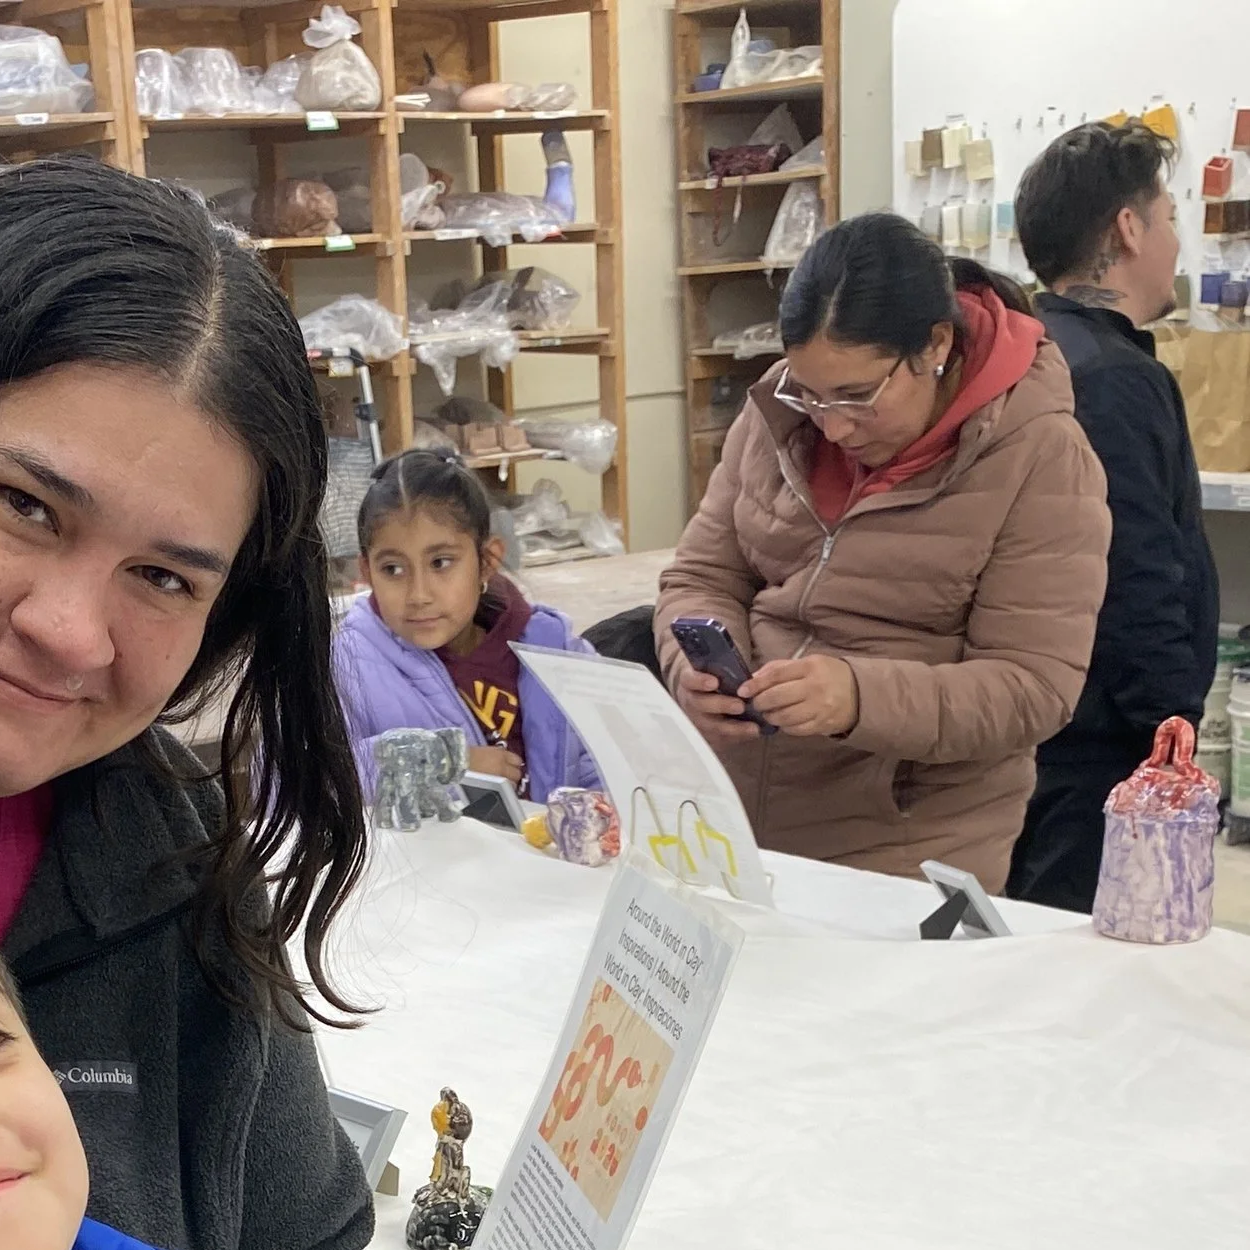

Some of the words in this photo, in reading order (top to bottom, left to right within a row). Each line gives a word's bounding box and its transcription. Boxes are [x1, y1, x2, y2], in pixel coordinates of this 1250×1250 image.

[626, 898, 652, 929] Around
[650, 914, 661, 938] the
[661, 925, 681, 954] World
[679, 938, 688, 960] in
[604, 952, 624, 981] World
[621, 966, 629, 988] in
[642, 990, 683, 1041] Inspiraciones
[618, 927, 655, 971] Inspirations
[655, 961, 680, 995] Around
[679, 977, 690, 1005] the
[67, 1067, 133, 1085] Columbia
